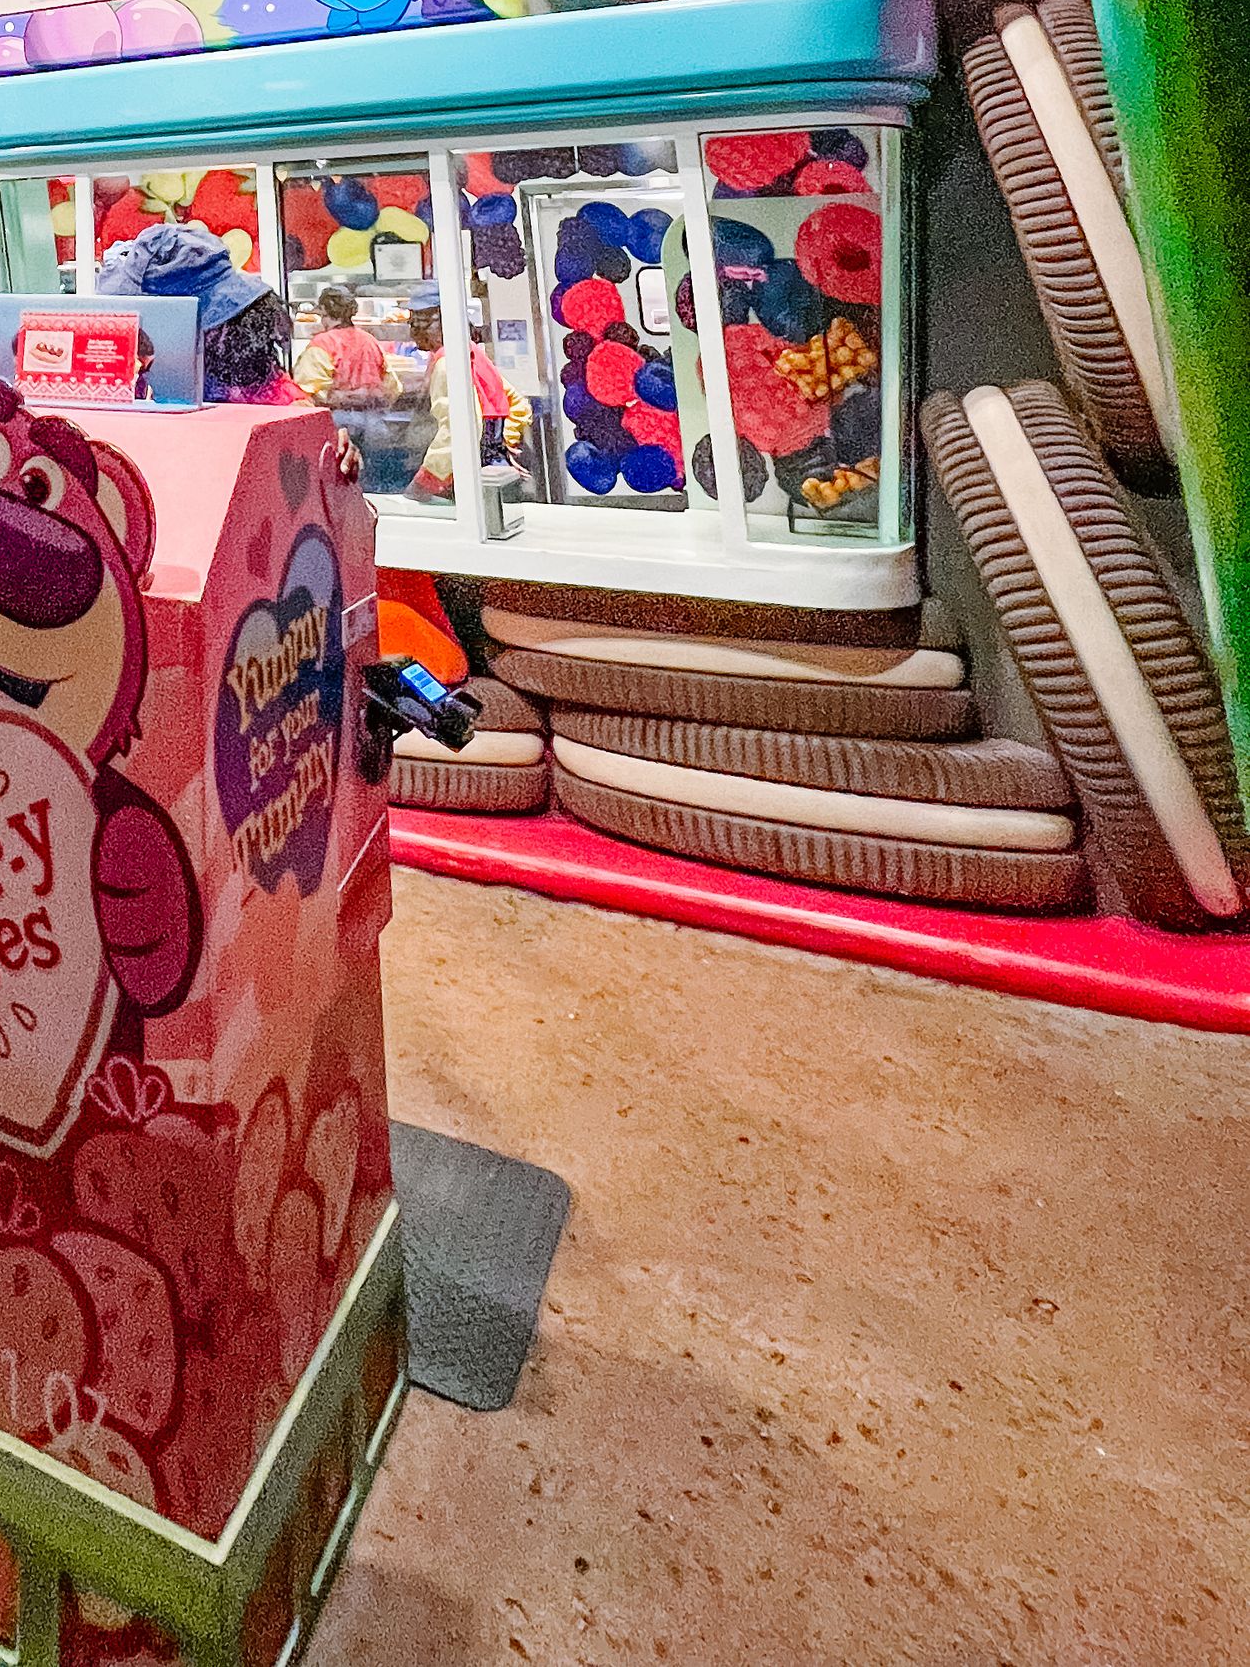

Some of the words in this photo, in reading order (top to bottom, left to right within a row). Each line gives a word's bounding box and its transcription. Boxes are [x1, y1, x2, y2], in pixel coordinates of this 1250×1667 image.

[226, 605, 329, 735] Yummy
[229, 732, 334, 875] Tummy
[249, 727, 280, 794] for
[281, 688, 321, 765] your
